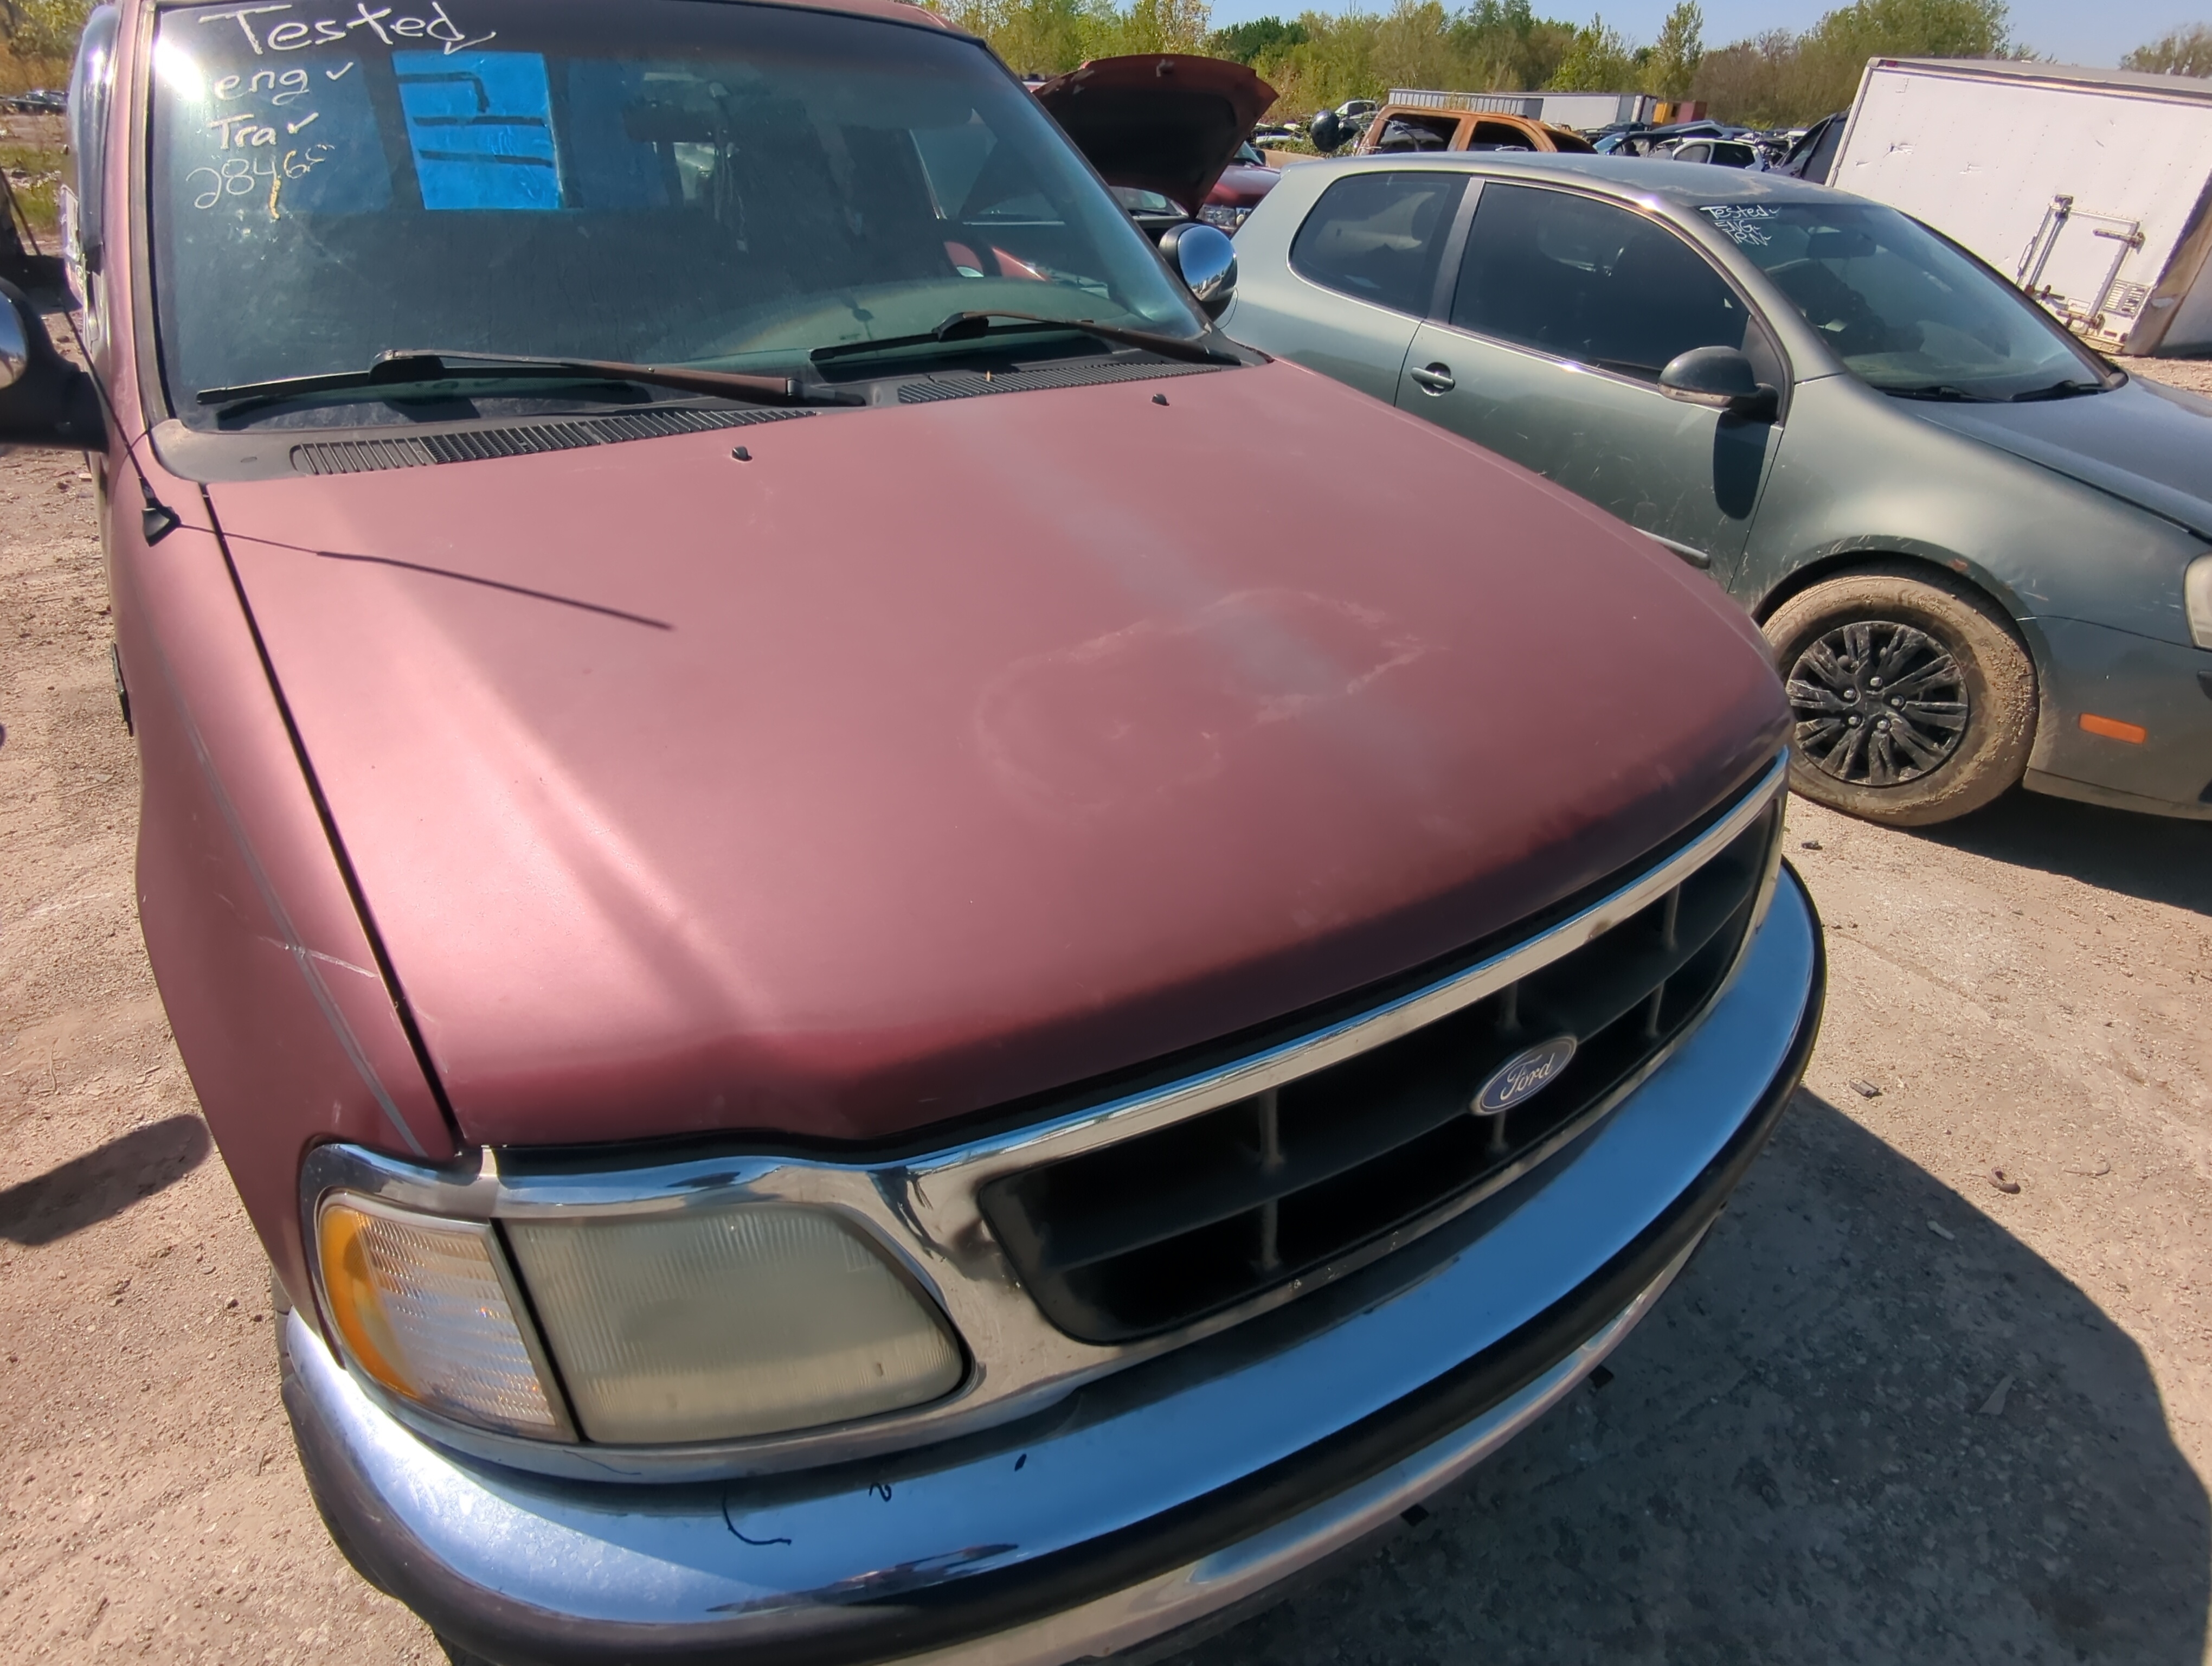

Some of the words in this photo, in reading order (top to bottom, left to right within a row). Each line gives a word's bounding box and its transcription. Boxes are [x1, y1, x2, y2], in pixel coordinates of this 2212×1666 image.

[198, 2, 466, 55] Tested
[214, 68, 310, 106] eng
[206, 113, 276, 150] Tra
[1699, 204, 1770, 219] Tested
[1500, 1052, 1555, 1100] Ford
